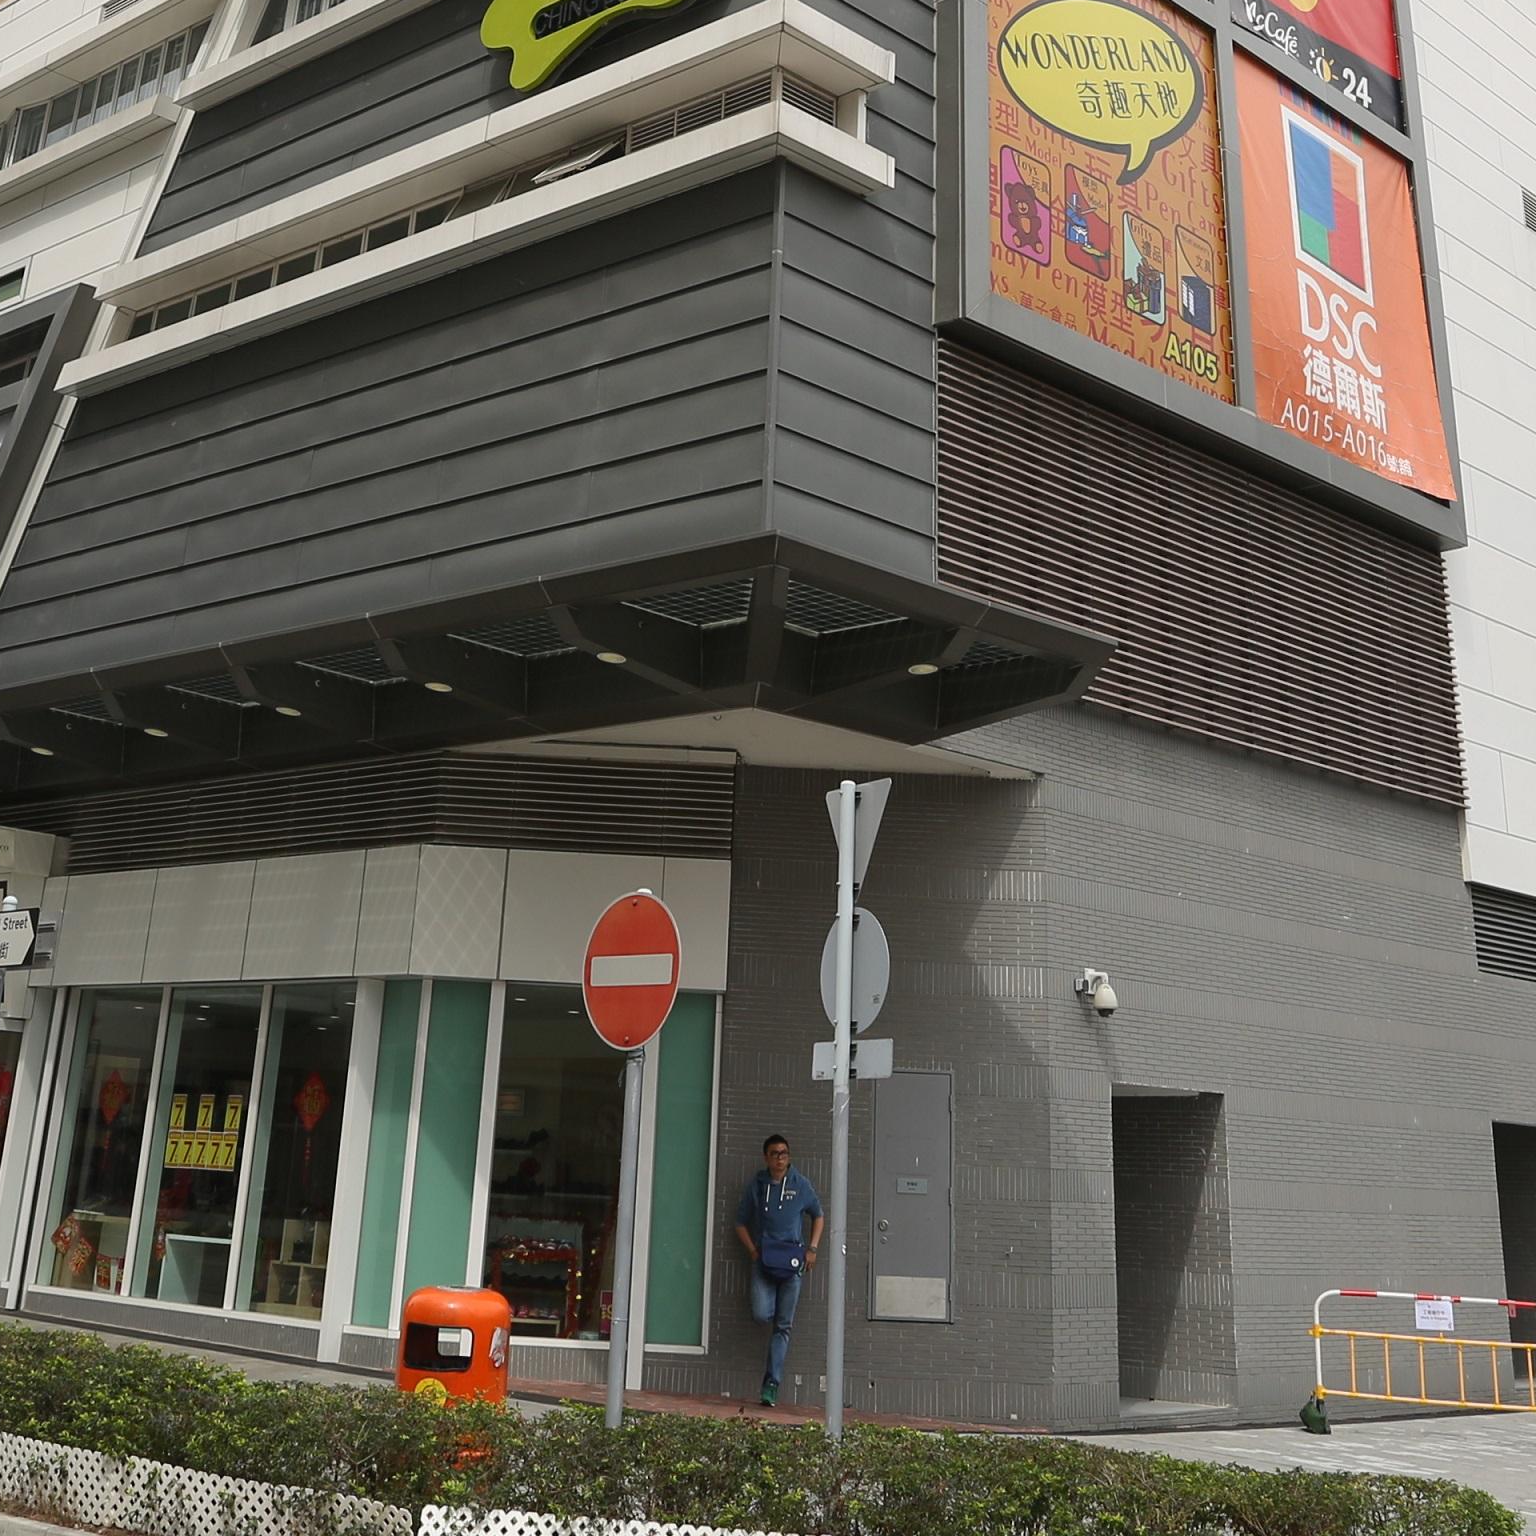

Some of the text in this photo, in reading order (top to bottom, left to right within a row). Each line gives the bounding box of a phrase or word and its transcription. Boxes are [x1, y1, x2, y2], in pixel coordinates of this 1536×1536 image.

[1002, 31, 1187, 74] WONDERLAND
[1075, 79, 1182, 120] 奇趣天地
[1343, 67, 1373, 109] 24
[1297, 267, 1382, 378] DSC
[1164, 331, 1219, 384] A105
[1302, 343, 1388, 435] 德爾斯
[4, 915, 28, 931] Street
